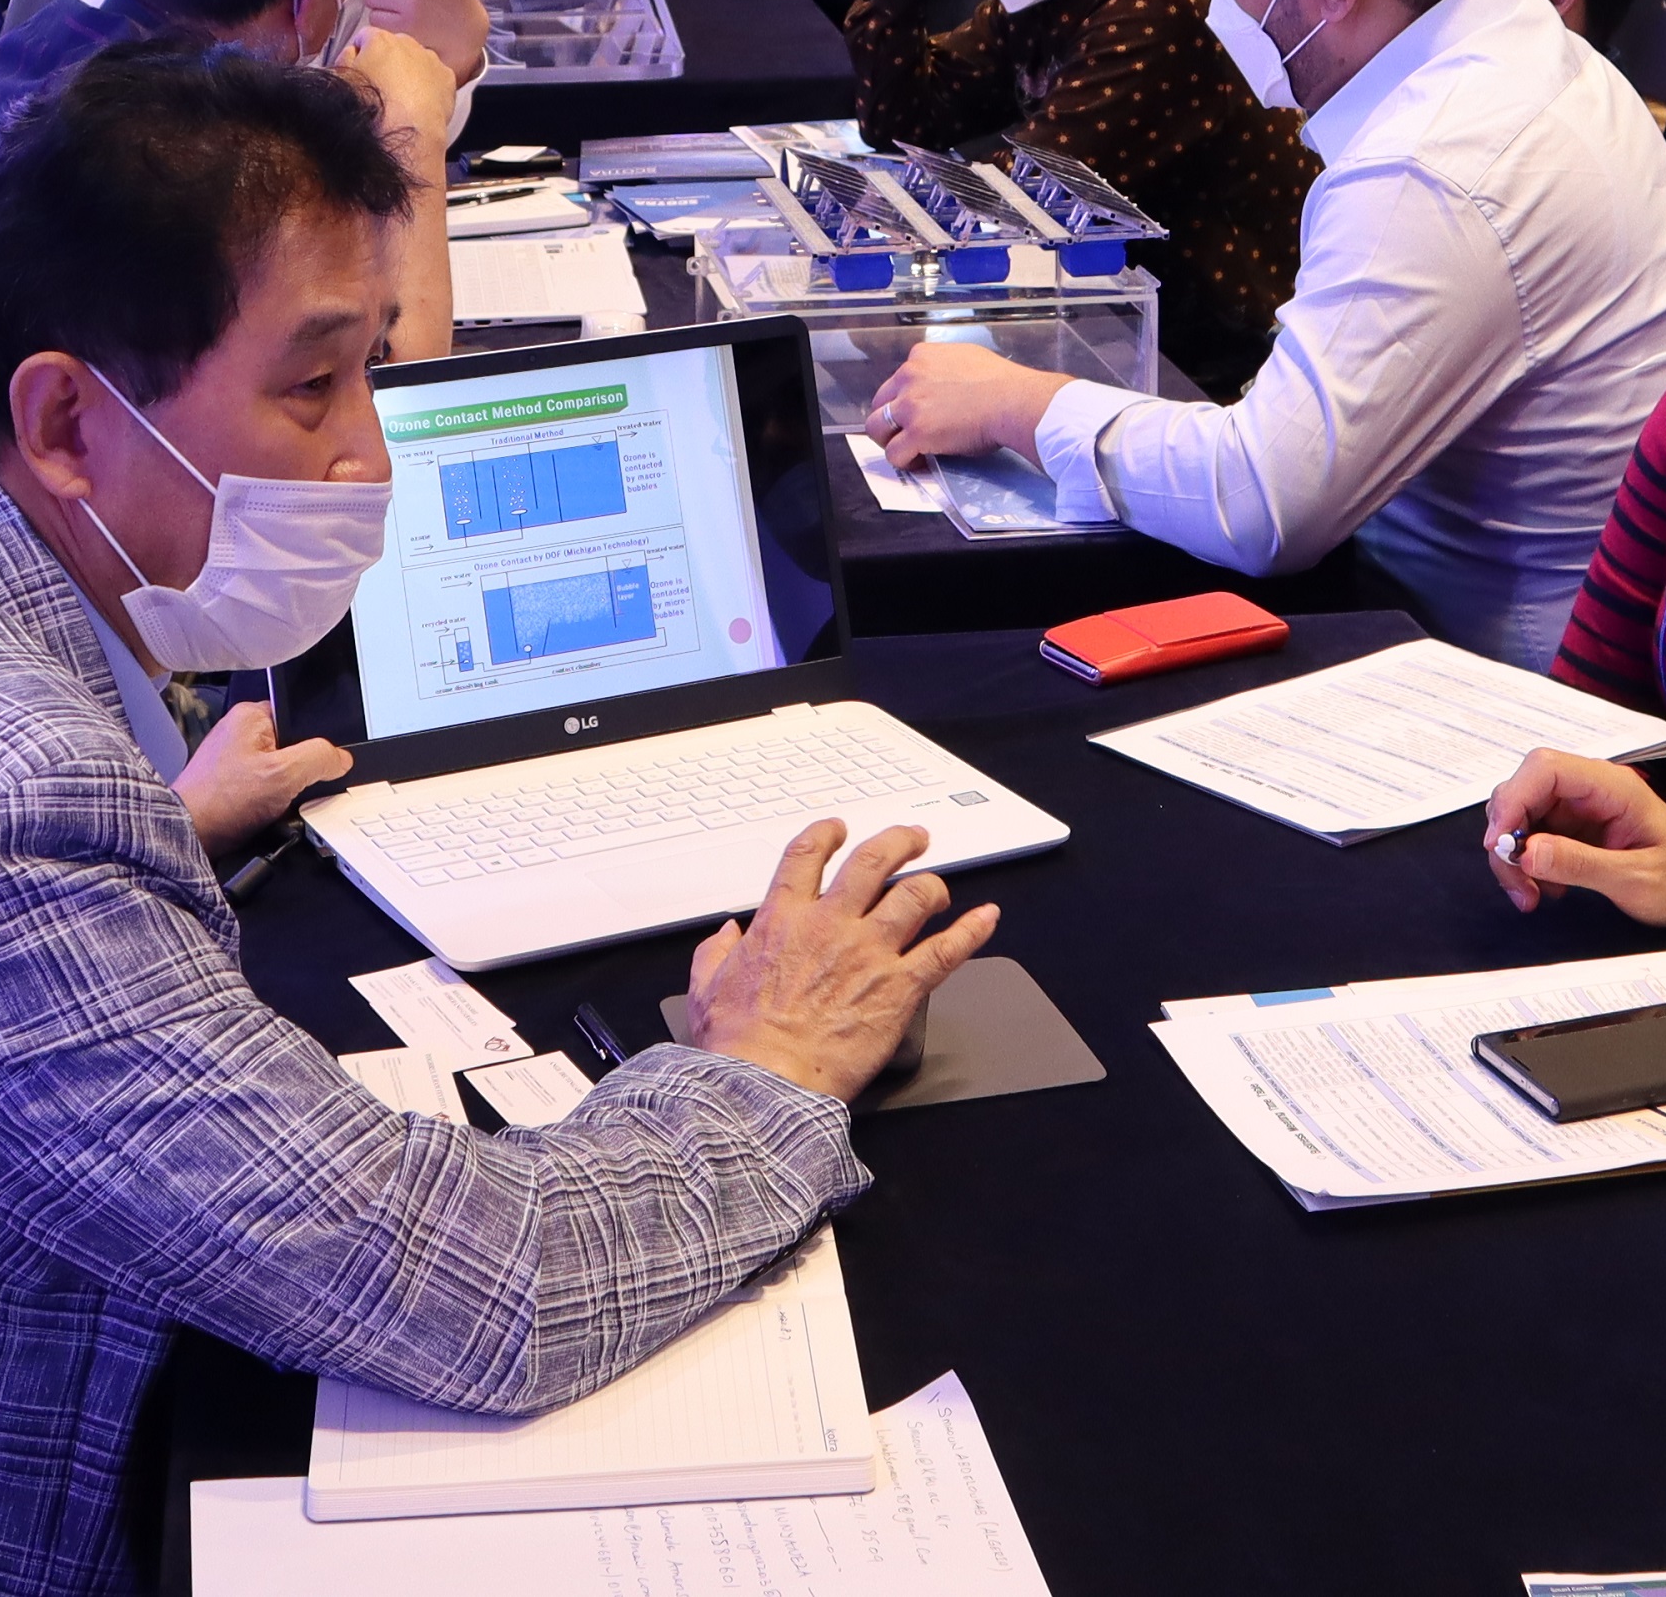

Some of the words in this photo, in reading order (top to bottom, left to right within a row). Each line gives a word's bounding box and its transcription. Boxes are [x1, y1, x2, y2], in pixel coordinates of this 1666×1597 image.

[388, 416, 432, 434] Ozone
[435, 407, 489, 429] Contact
[492, 399, 542, 420] Method
[546, 390, 624, 413] Comparison
[490, 431, 534, 446] Traditional
[535, 427, 565, 441] Method
[623, 453, 648, 464] Ozone
[649, 451, 657, 460] is
[624, 459, 664, 473] contacted
[626, 473, 636, 484] by
[627, 482, 659, 494] bubbles
[473, 559, 499, 572] Ozone
[501, 553, 533, 568] Contact
[534, 552, 544, 565] by
[545, 547, 562, 561] DOF
[563, 541, 601, 559] (Michigan
[602, 535, 651, 554] Technology)
[650, 579, 674, 590] Ozone
[675, 577, 683, 586] is
[651, 586, 690, 599] contacted
[654, 609, 685, 620] bubbles
[581, 715, 600, 731] LG
[826, 1427, 839, 1453] kotra
